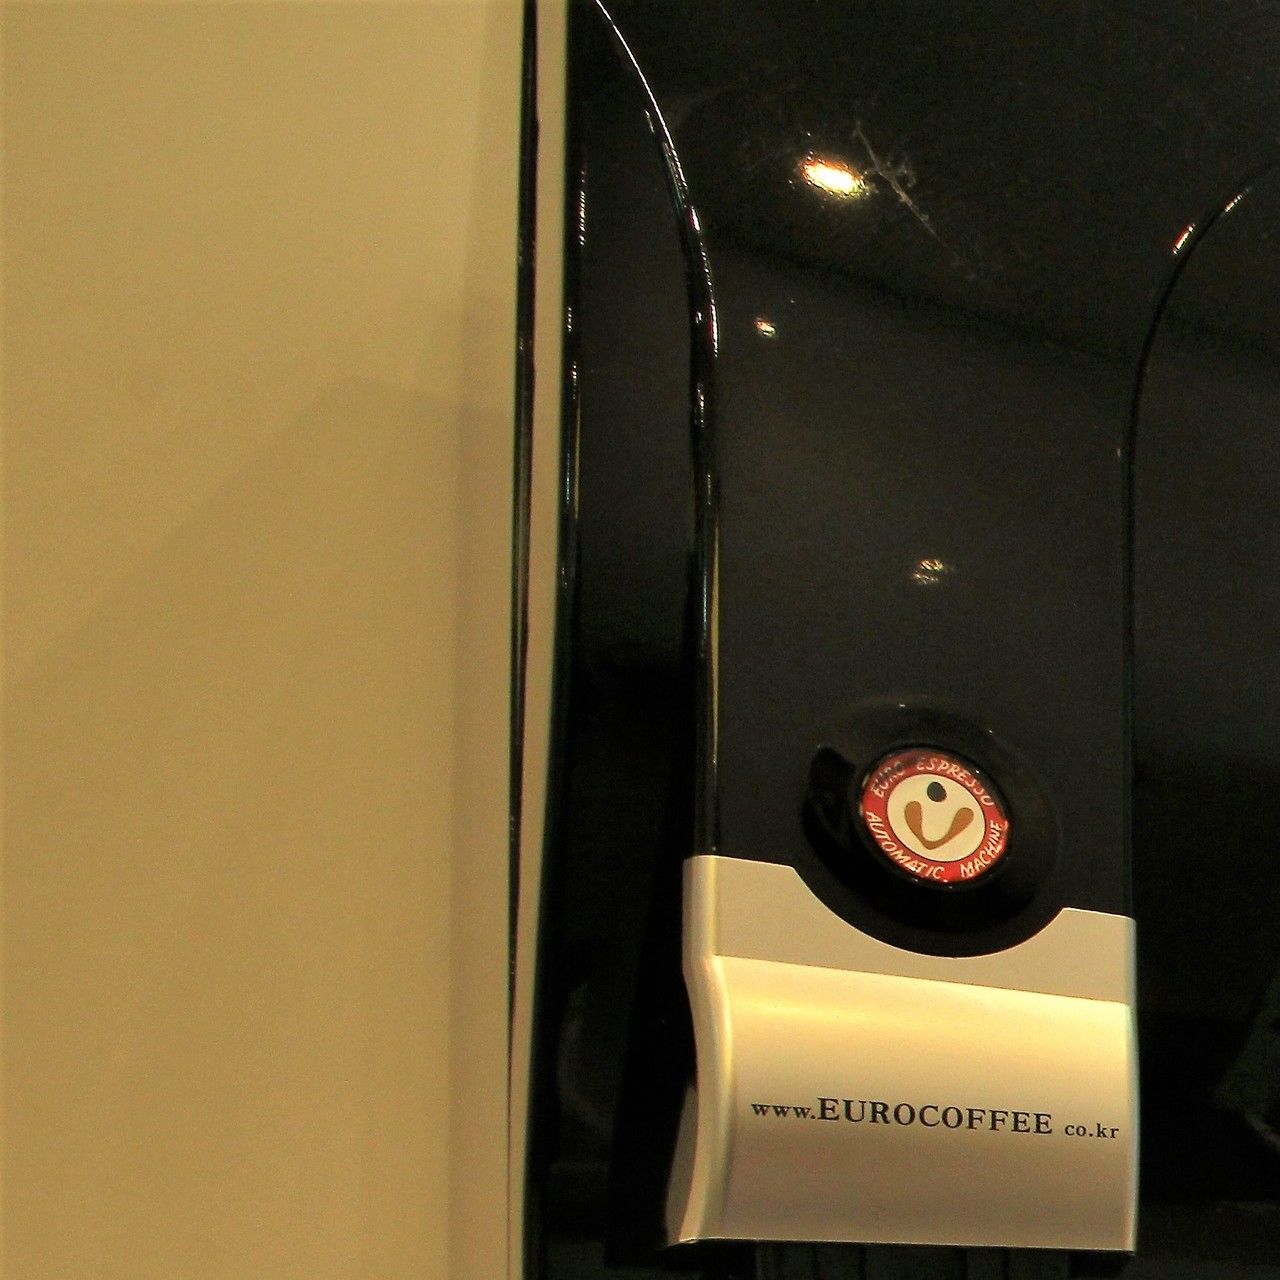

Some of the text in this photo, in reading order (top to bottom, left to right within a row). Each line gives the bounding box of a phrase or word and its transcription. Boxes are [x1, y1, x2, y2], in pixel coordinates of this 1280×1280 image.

[865, 811, 1004, 880] AUTOMATIC MACHINE
[1063, 1121, 1121, 1140] co.kr
